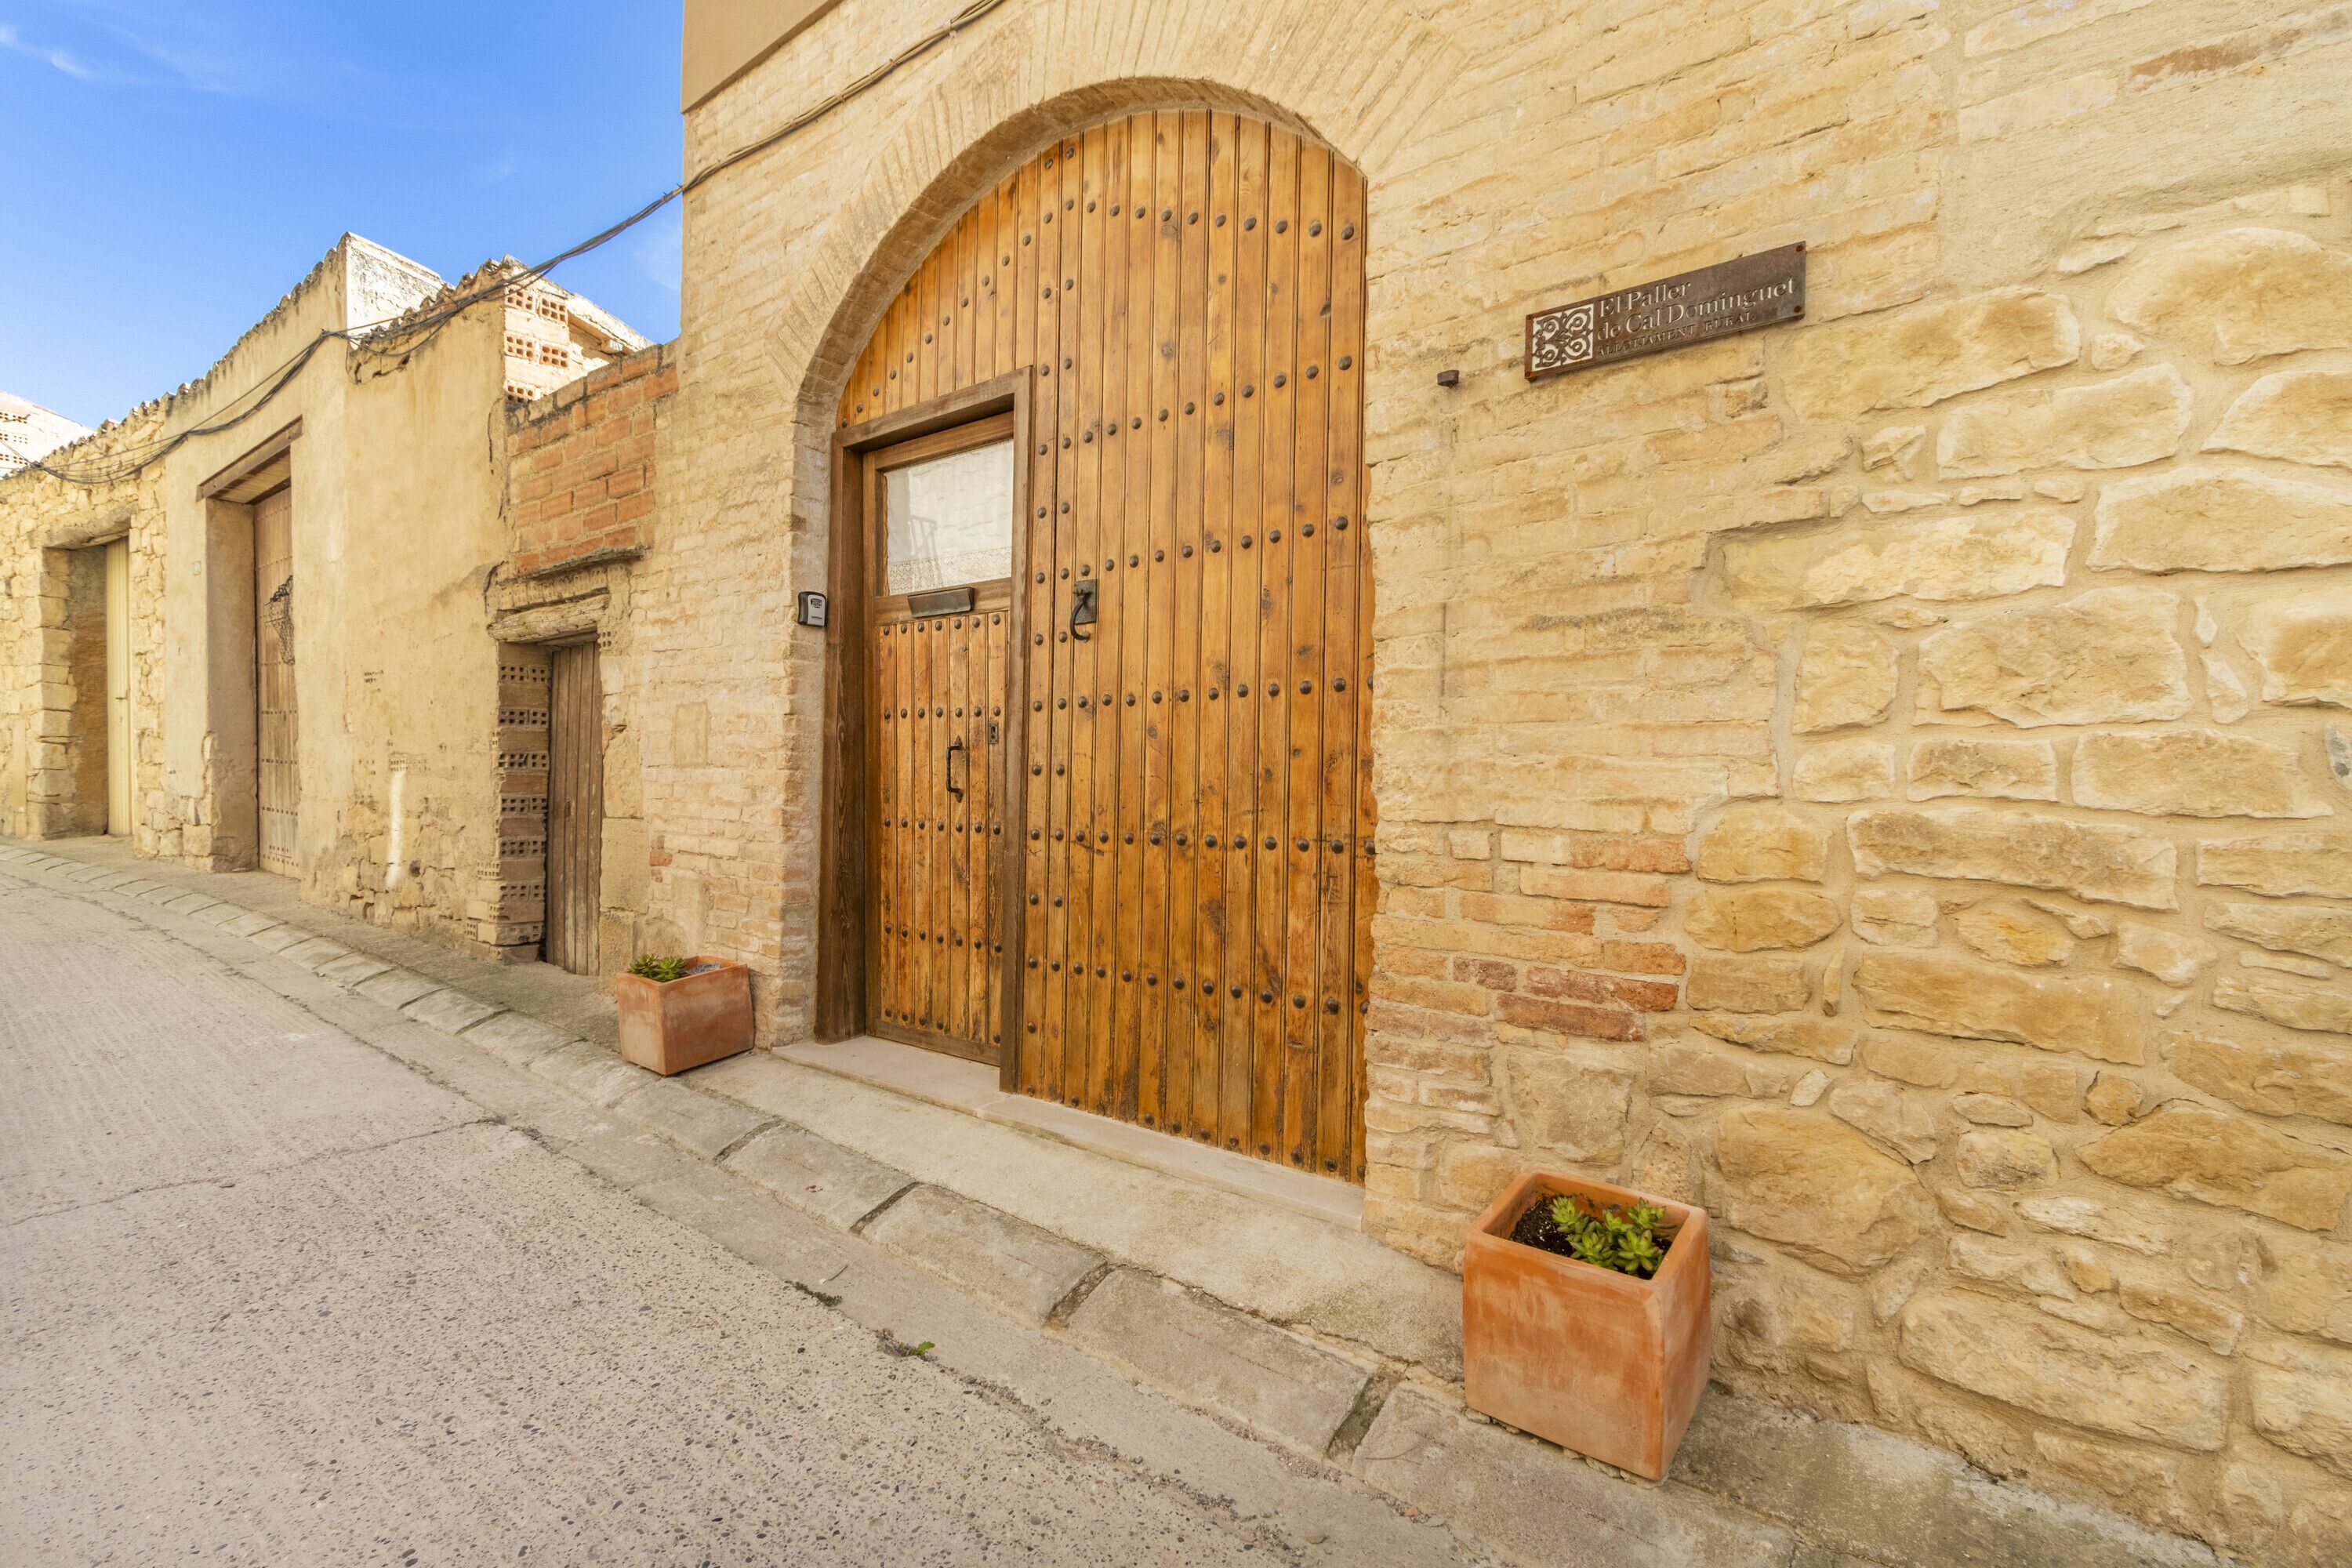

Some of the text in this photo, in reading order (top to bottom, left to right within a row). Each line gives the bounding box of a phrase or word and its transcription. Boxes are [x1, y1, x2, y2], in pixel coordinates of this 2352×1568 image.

[1598, 275, 1797, 340] de Cal Dominguet
[1599, 282, 1691, 317] El Paller
[1598, 310, 1756, 356] ALLOTJAMENT RURAL
